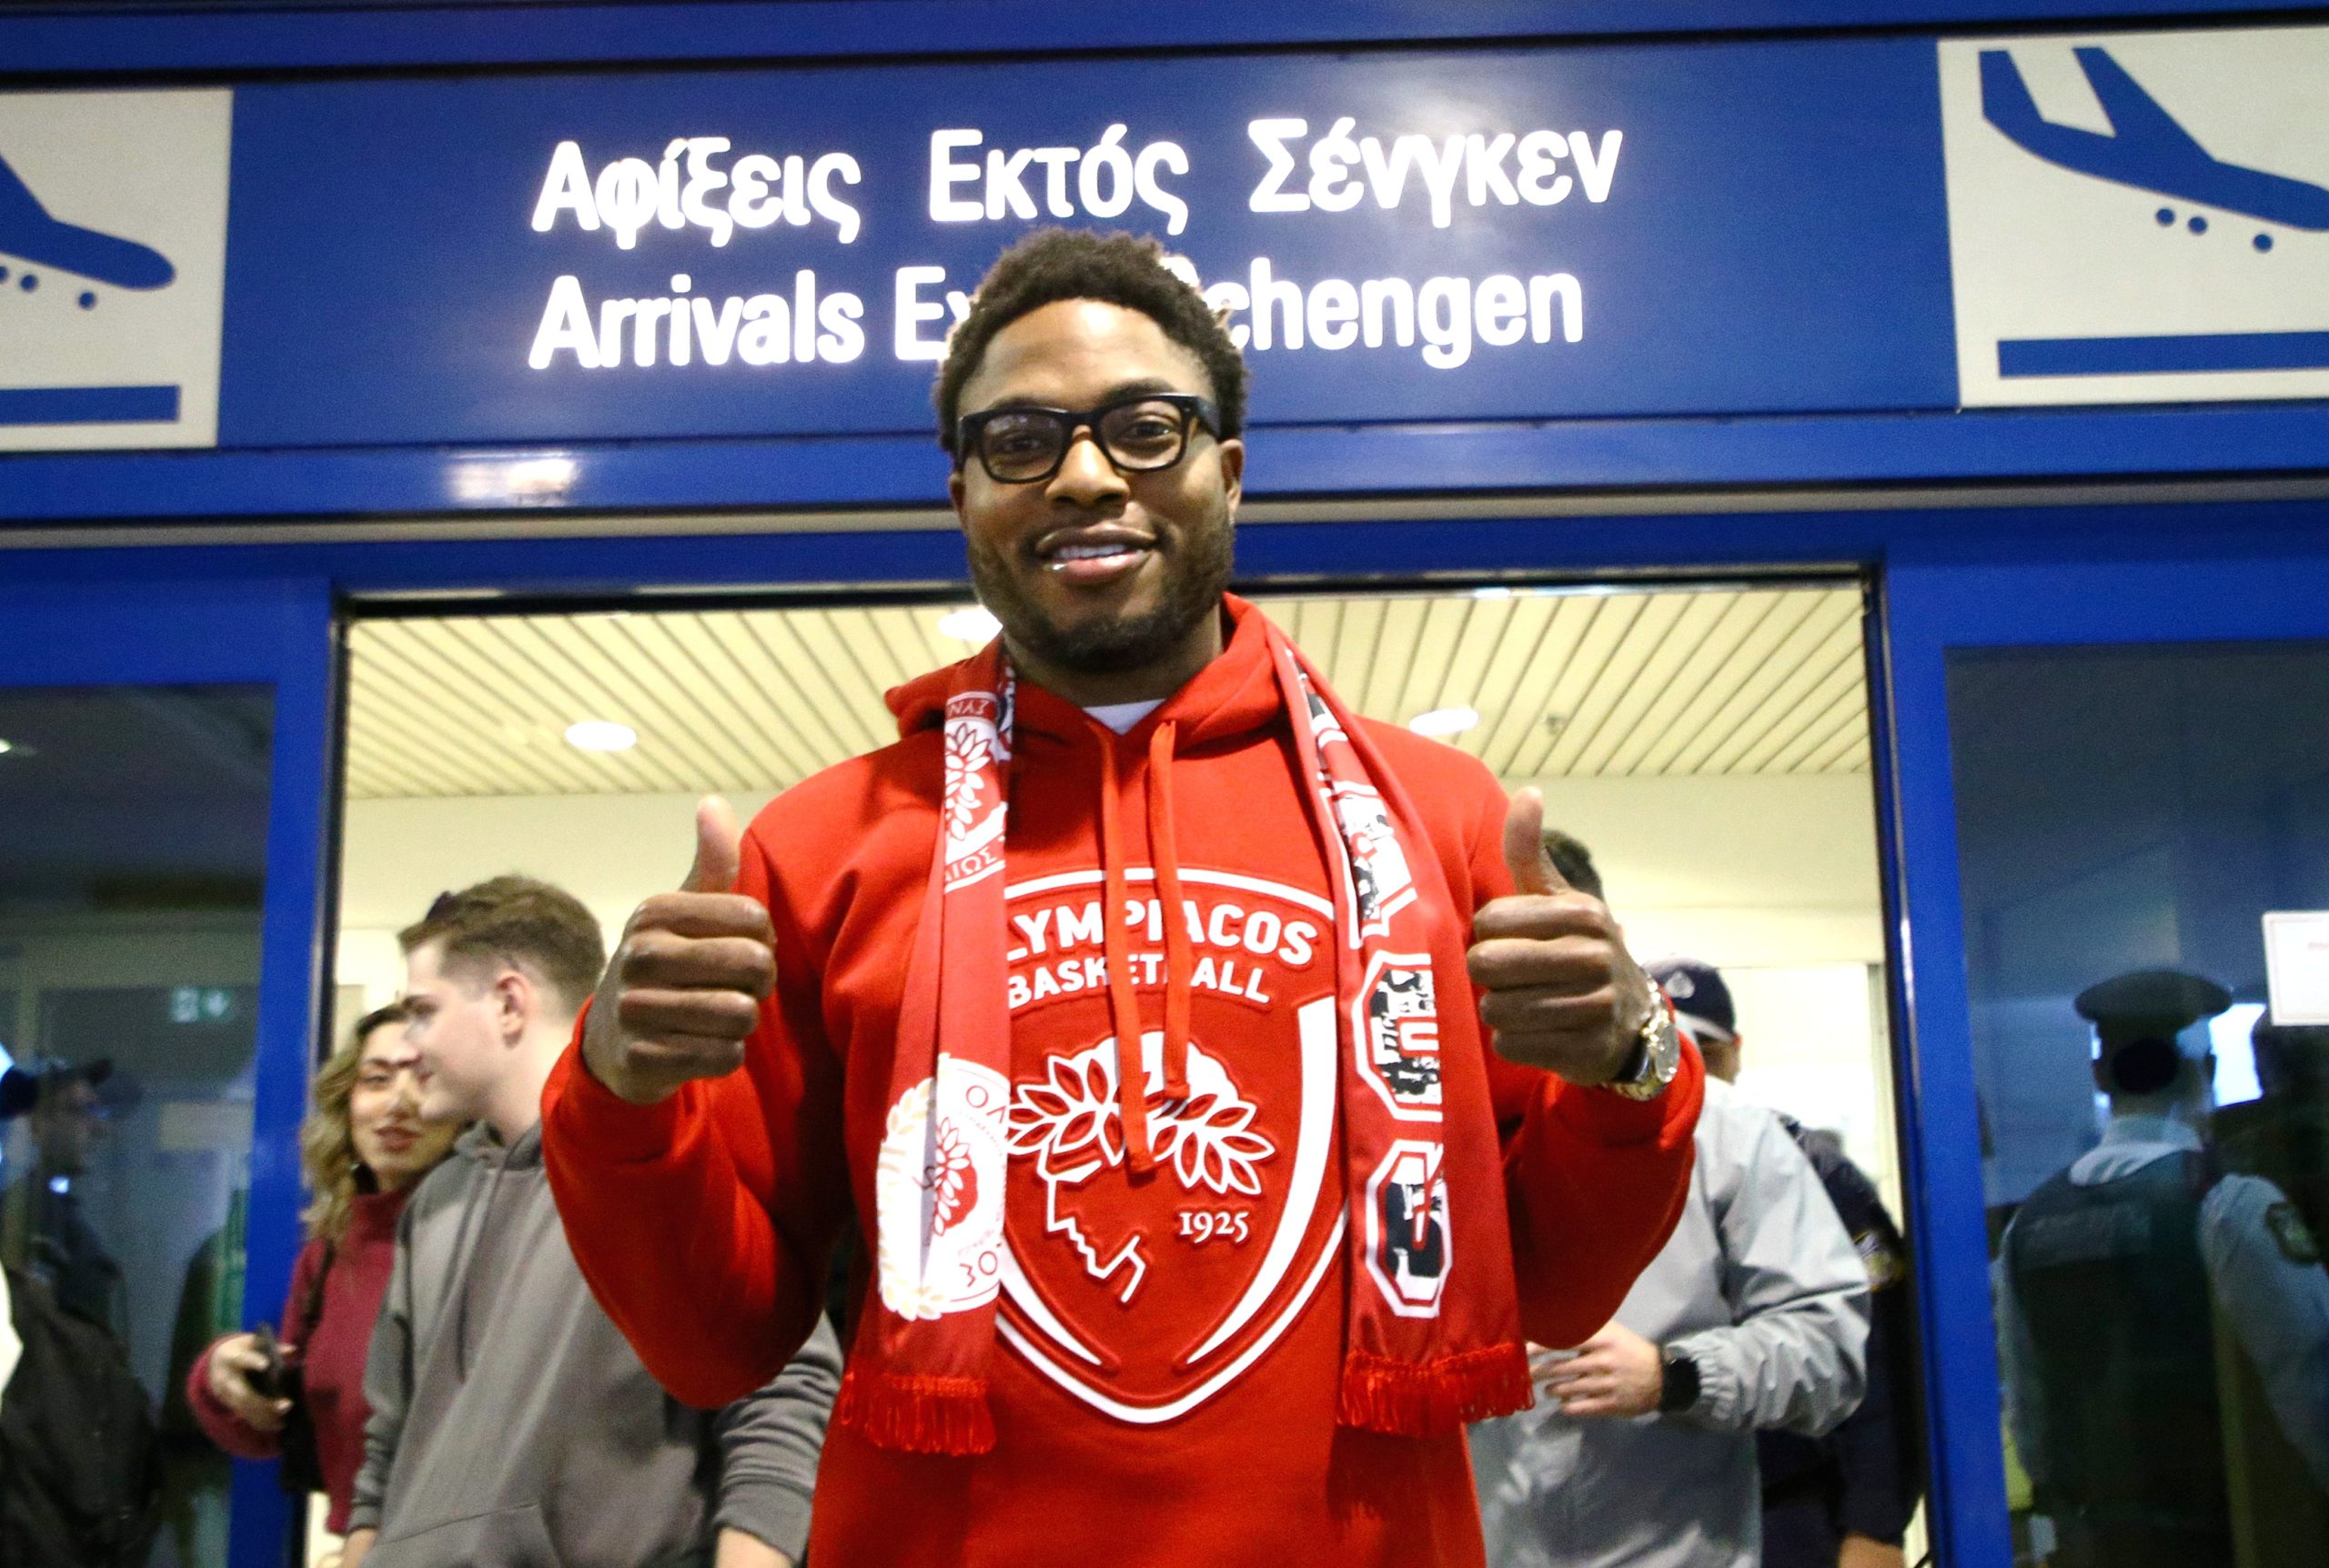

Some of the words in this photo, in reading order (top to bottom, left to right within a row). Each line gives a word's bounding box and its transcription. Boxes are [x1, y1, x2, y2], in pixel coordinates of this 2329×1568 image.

[531, 137, 861, 249] Αφίξεις
[929, 124, 1189, 236] Εκτός
[1247, 116, 1623, 228] Σένγκεν
[528, 269, 865, 369] Arrivals
[1160, 255, 1583, 369] chengen
[1006, 899, 1318, 965] YMPICOS
[1008, 953, 1271, 1009] BASKTALL
[1179, 1211, 1250, 1243] 1925
